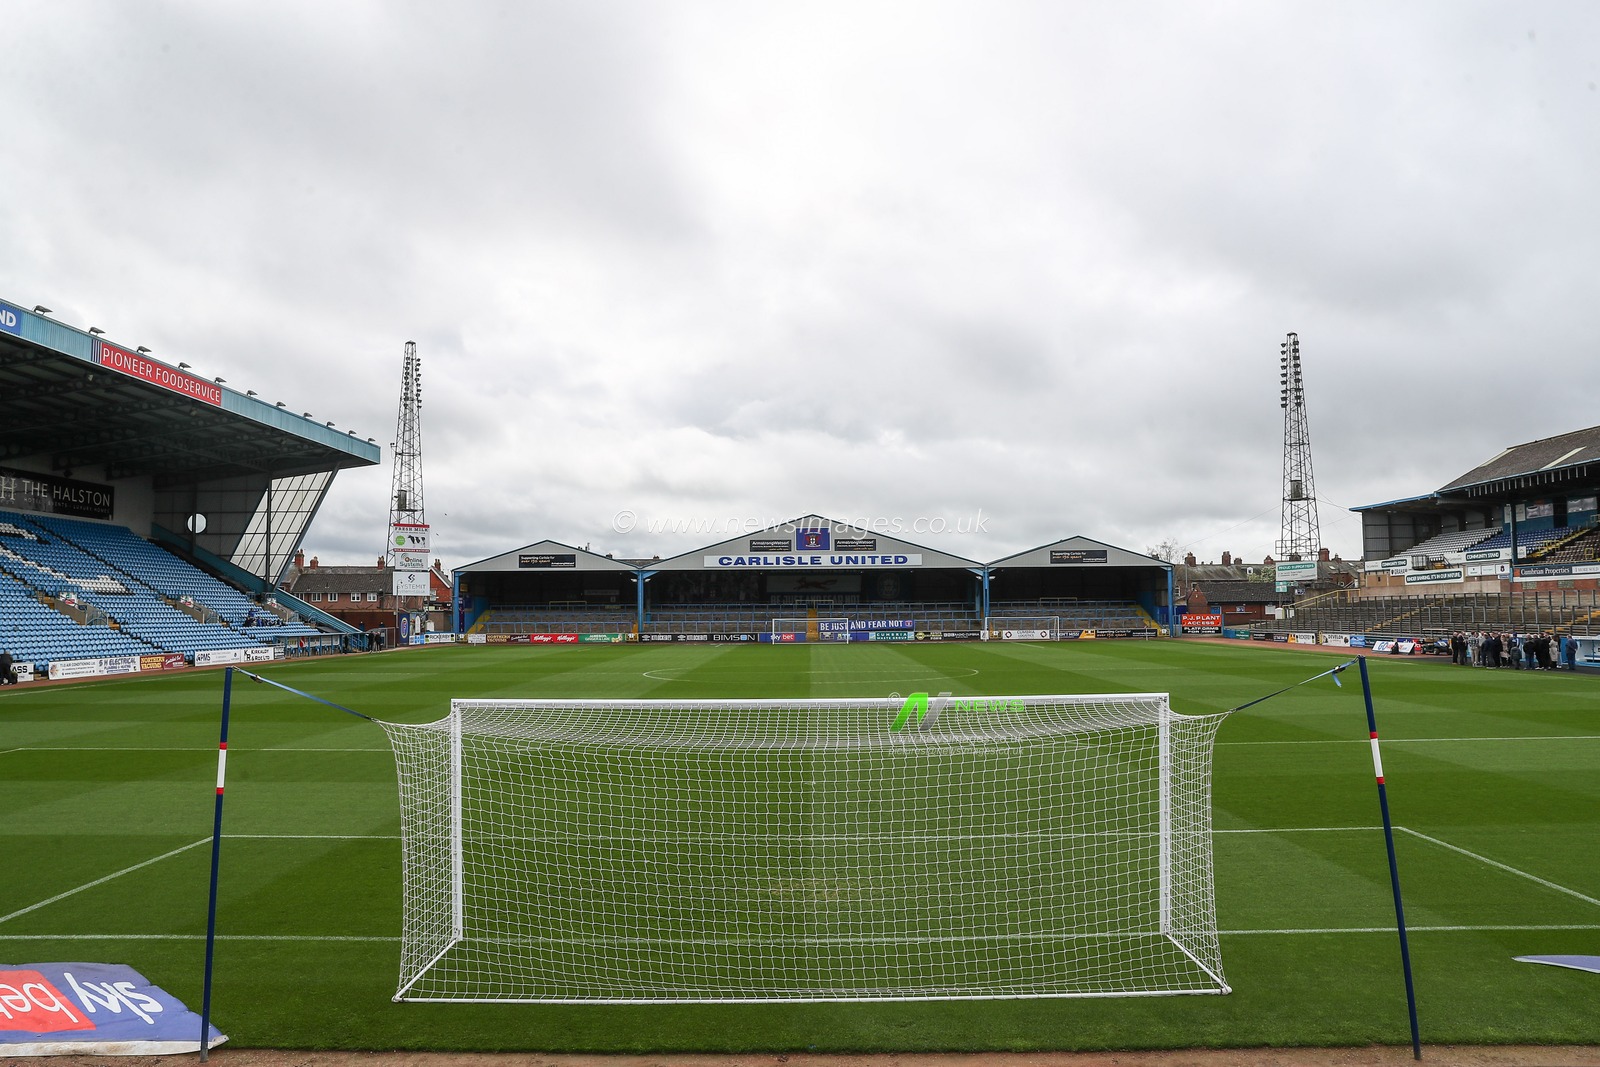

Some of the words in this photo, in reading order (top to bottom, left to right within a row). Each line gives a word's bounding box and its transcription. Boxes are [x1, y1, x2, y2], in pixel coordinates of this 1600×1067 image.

[102, 347, 153, 378] PIONEER
[155, 367, 221, 402] FOODSERVICE
[22, 480, 48, 498] THE
[53, 485, 110, 507] HALSTON
[718, 556, 822, 566] CARLISLE
[830, 555, 908, 565] UNITED
[1520, 567, 1544, 576] Cumbrian
[1545, 566, 1570, 576] Properties
[831, 622, 848, 630] JUST
[850, 621, 866, 629] AND
[868, 620, 886, 628] FEAR
[109, 657, 136, 665] ELECTRICAL
[63, 972, 163, 1024] sky
